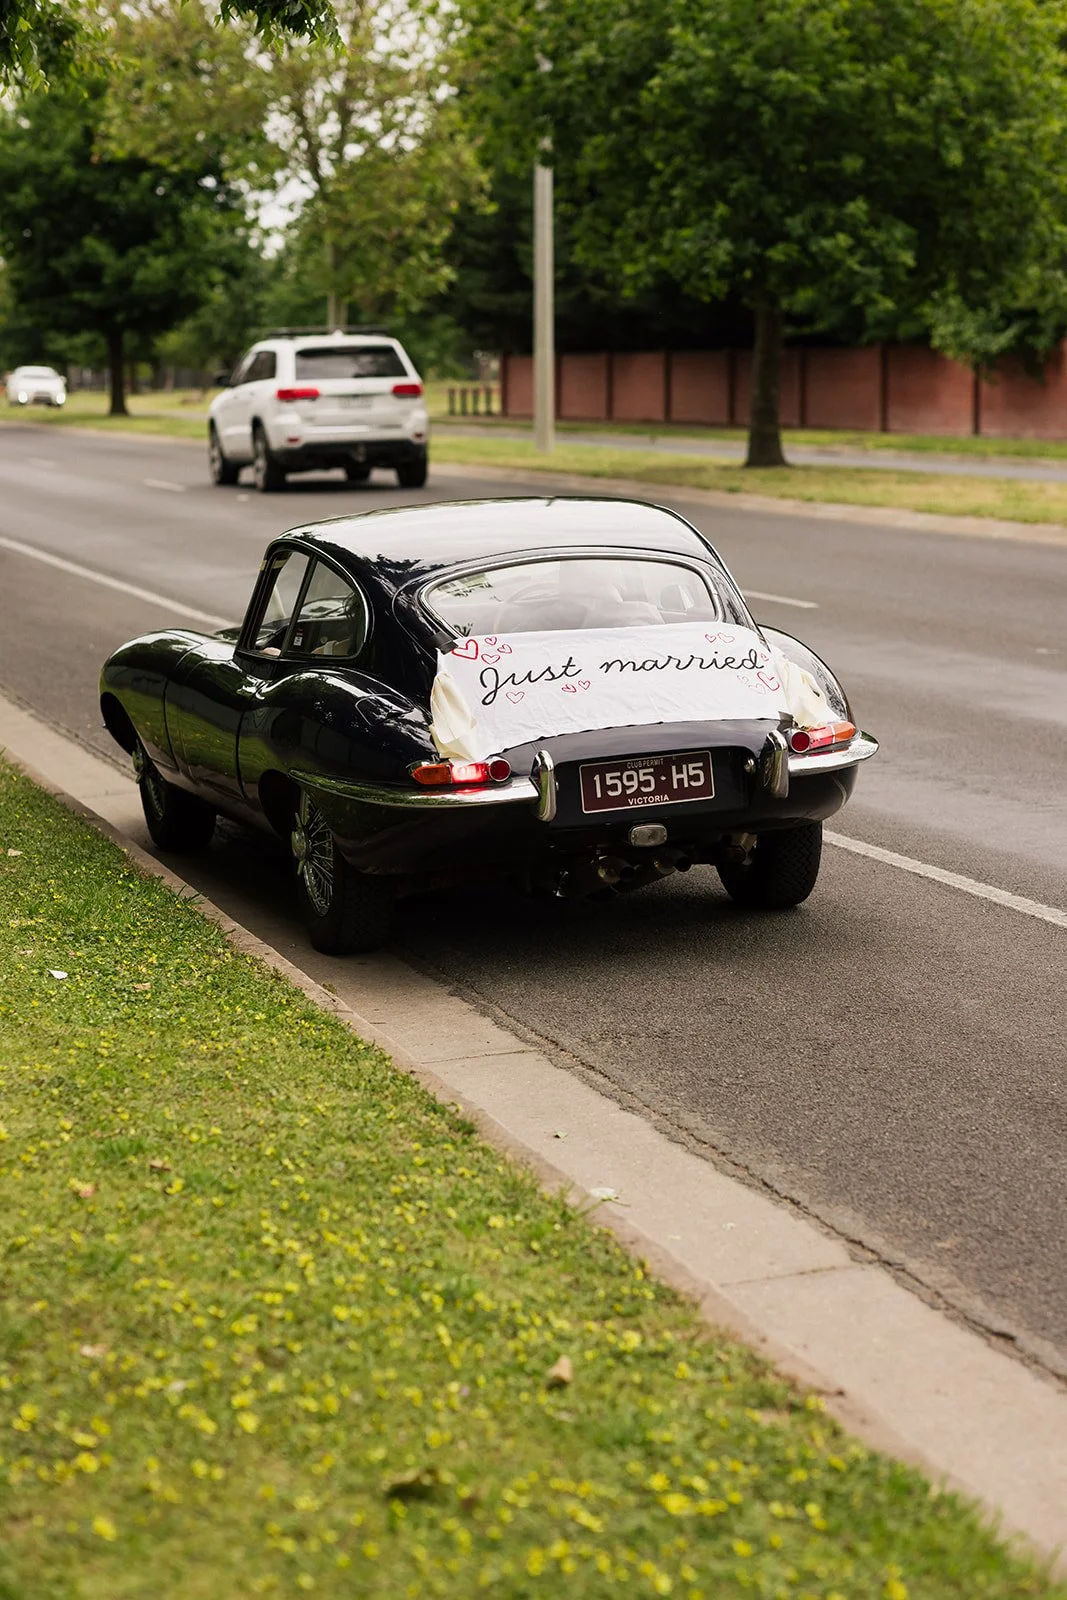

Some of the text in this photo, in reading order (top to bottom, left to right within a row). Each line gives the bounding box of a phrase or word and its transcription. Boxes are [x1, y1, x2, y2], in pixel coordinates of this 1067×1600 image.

[479, 649, 765, 705] Just married
[626, 758, 664, 769] CLUB PERMIT
[628, 794, 670, 805] VICTORIA
